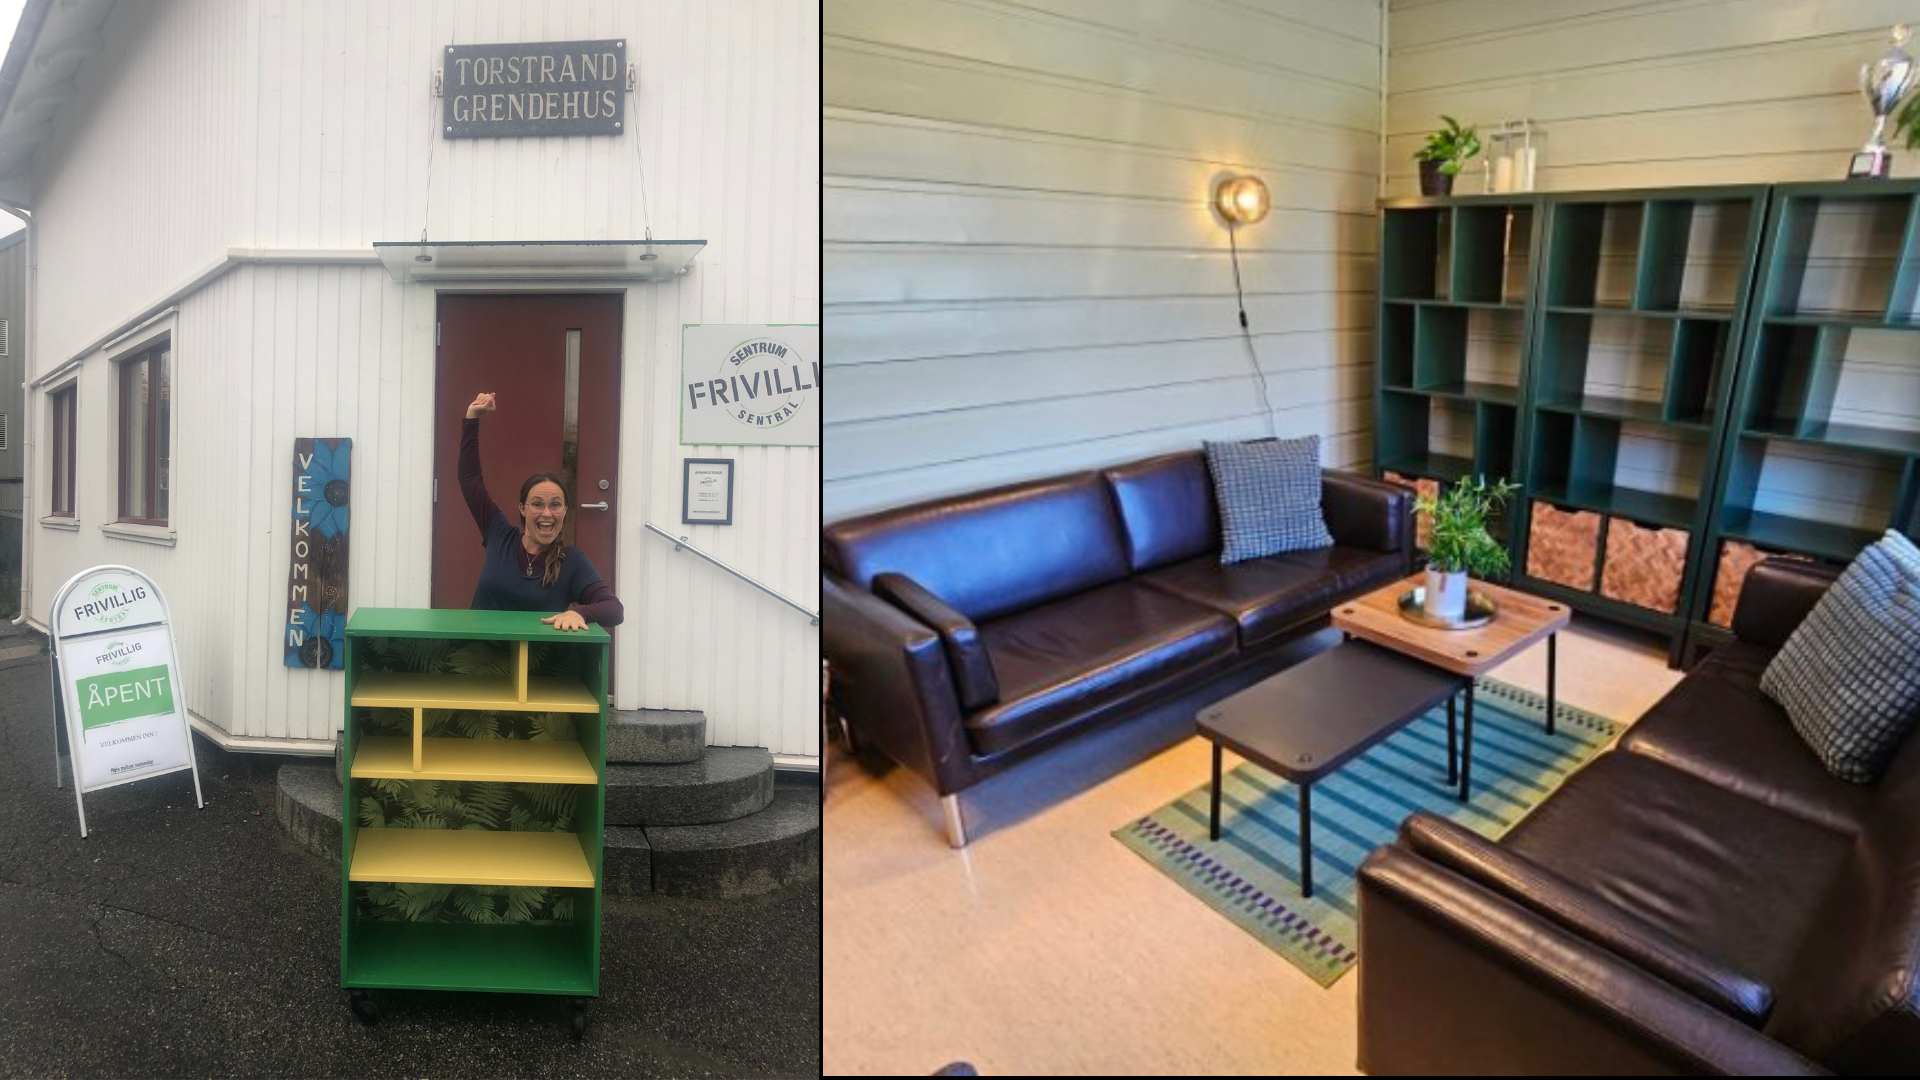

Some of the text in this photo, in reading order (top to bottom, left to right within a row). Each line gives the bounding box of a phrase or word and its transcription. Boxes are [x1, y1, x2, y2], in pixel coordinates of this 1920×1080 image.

[455, 53, 617, 86] TORSTRAND
[453, 90, 616, 122] GRENDEHUS
[730, 342, 788, 366] SENTRUM
[737, 401, 799, 426] SENTRAL
[289, 453, 314, 647] VELKOMMEN
[92, 584, 118, 597] SENTRUM
[74, 586, 146, 621] FRIVILLIG
[99, 608, 129, 623] SENTRAL
[95, 642, 142, 665] FRIVILLIG
[87, 676, 166, 710] ÅPENT
[99, 734, 142, 748] VELKOMMEN
